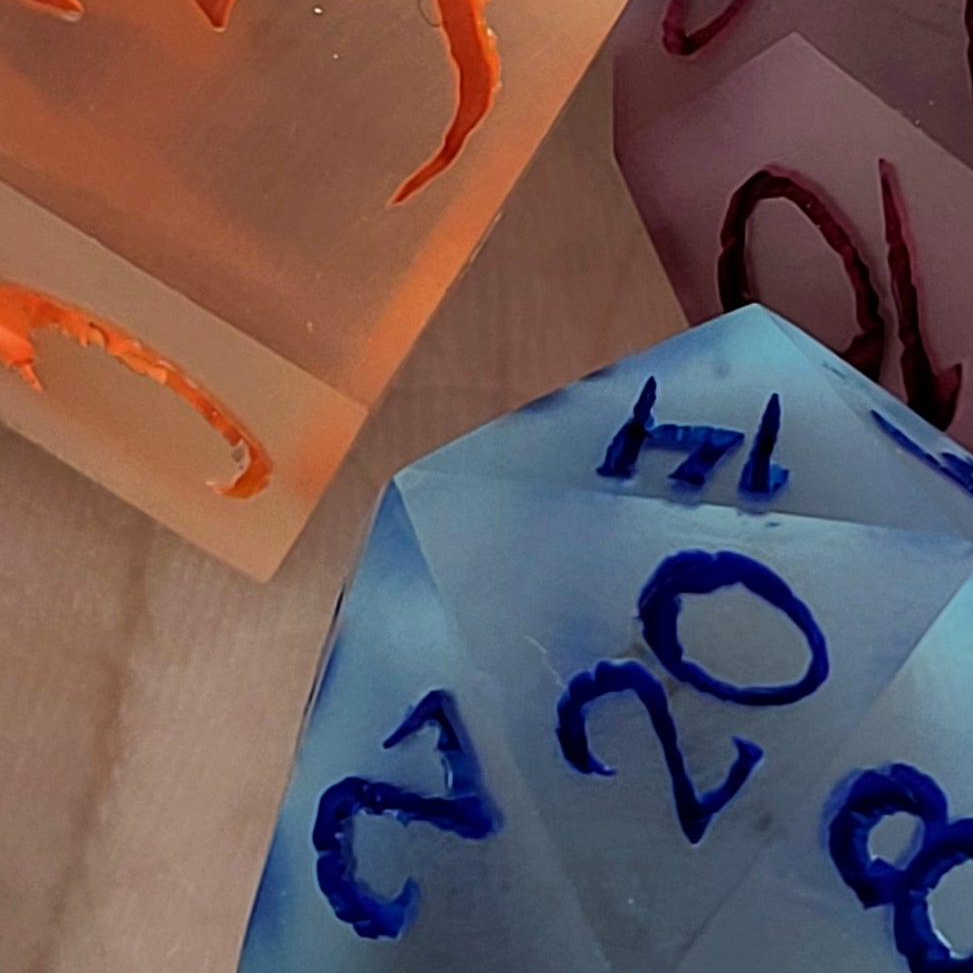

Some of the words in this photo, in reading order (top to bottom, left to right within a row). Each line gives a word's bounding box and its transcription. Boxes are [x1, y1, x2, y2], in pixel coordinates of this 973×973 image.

[597, 375, 789, 497] 14
[312, 688, 501, 939] 2
[556, 548, 830, 844] 20
